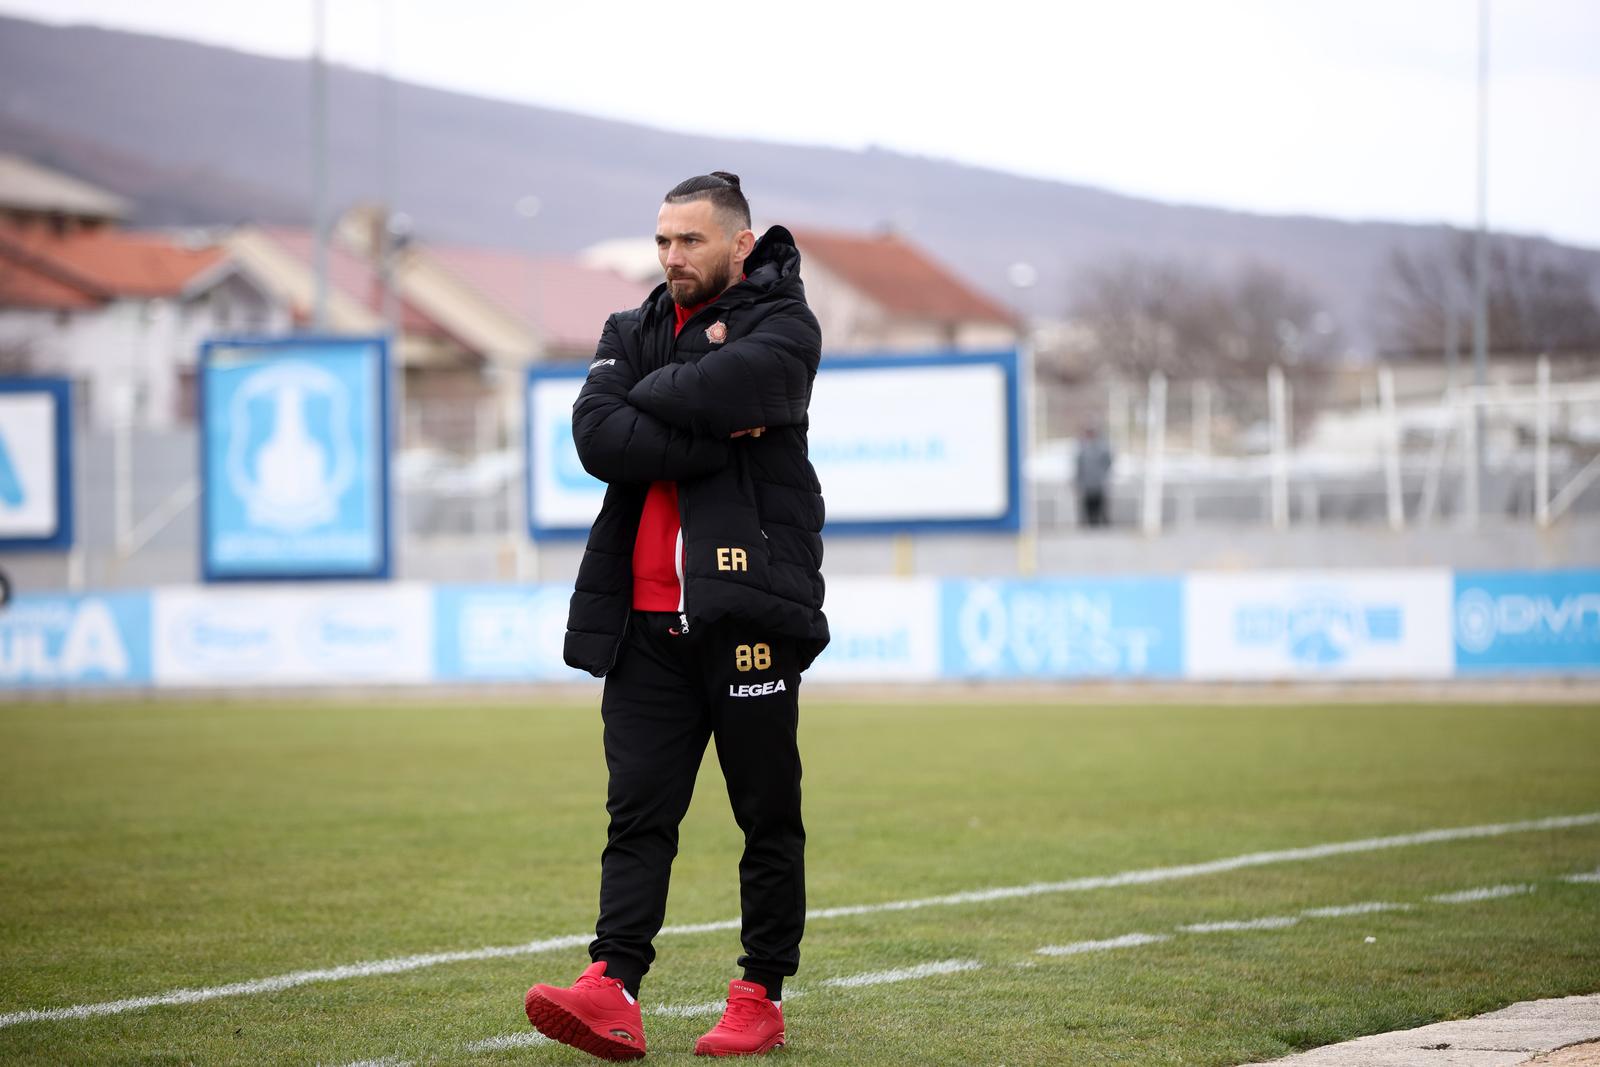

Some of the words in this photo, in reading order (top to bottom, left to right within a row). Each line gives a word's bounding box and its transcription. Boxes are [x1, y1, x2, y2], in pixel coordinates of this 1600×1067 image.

[716, 547, 748, 572] ER
[735, 642, 772, 672] 88
[729, 679, 787, 698] LEGEA
